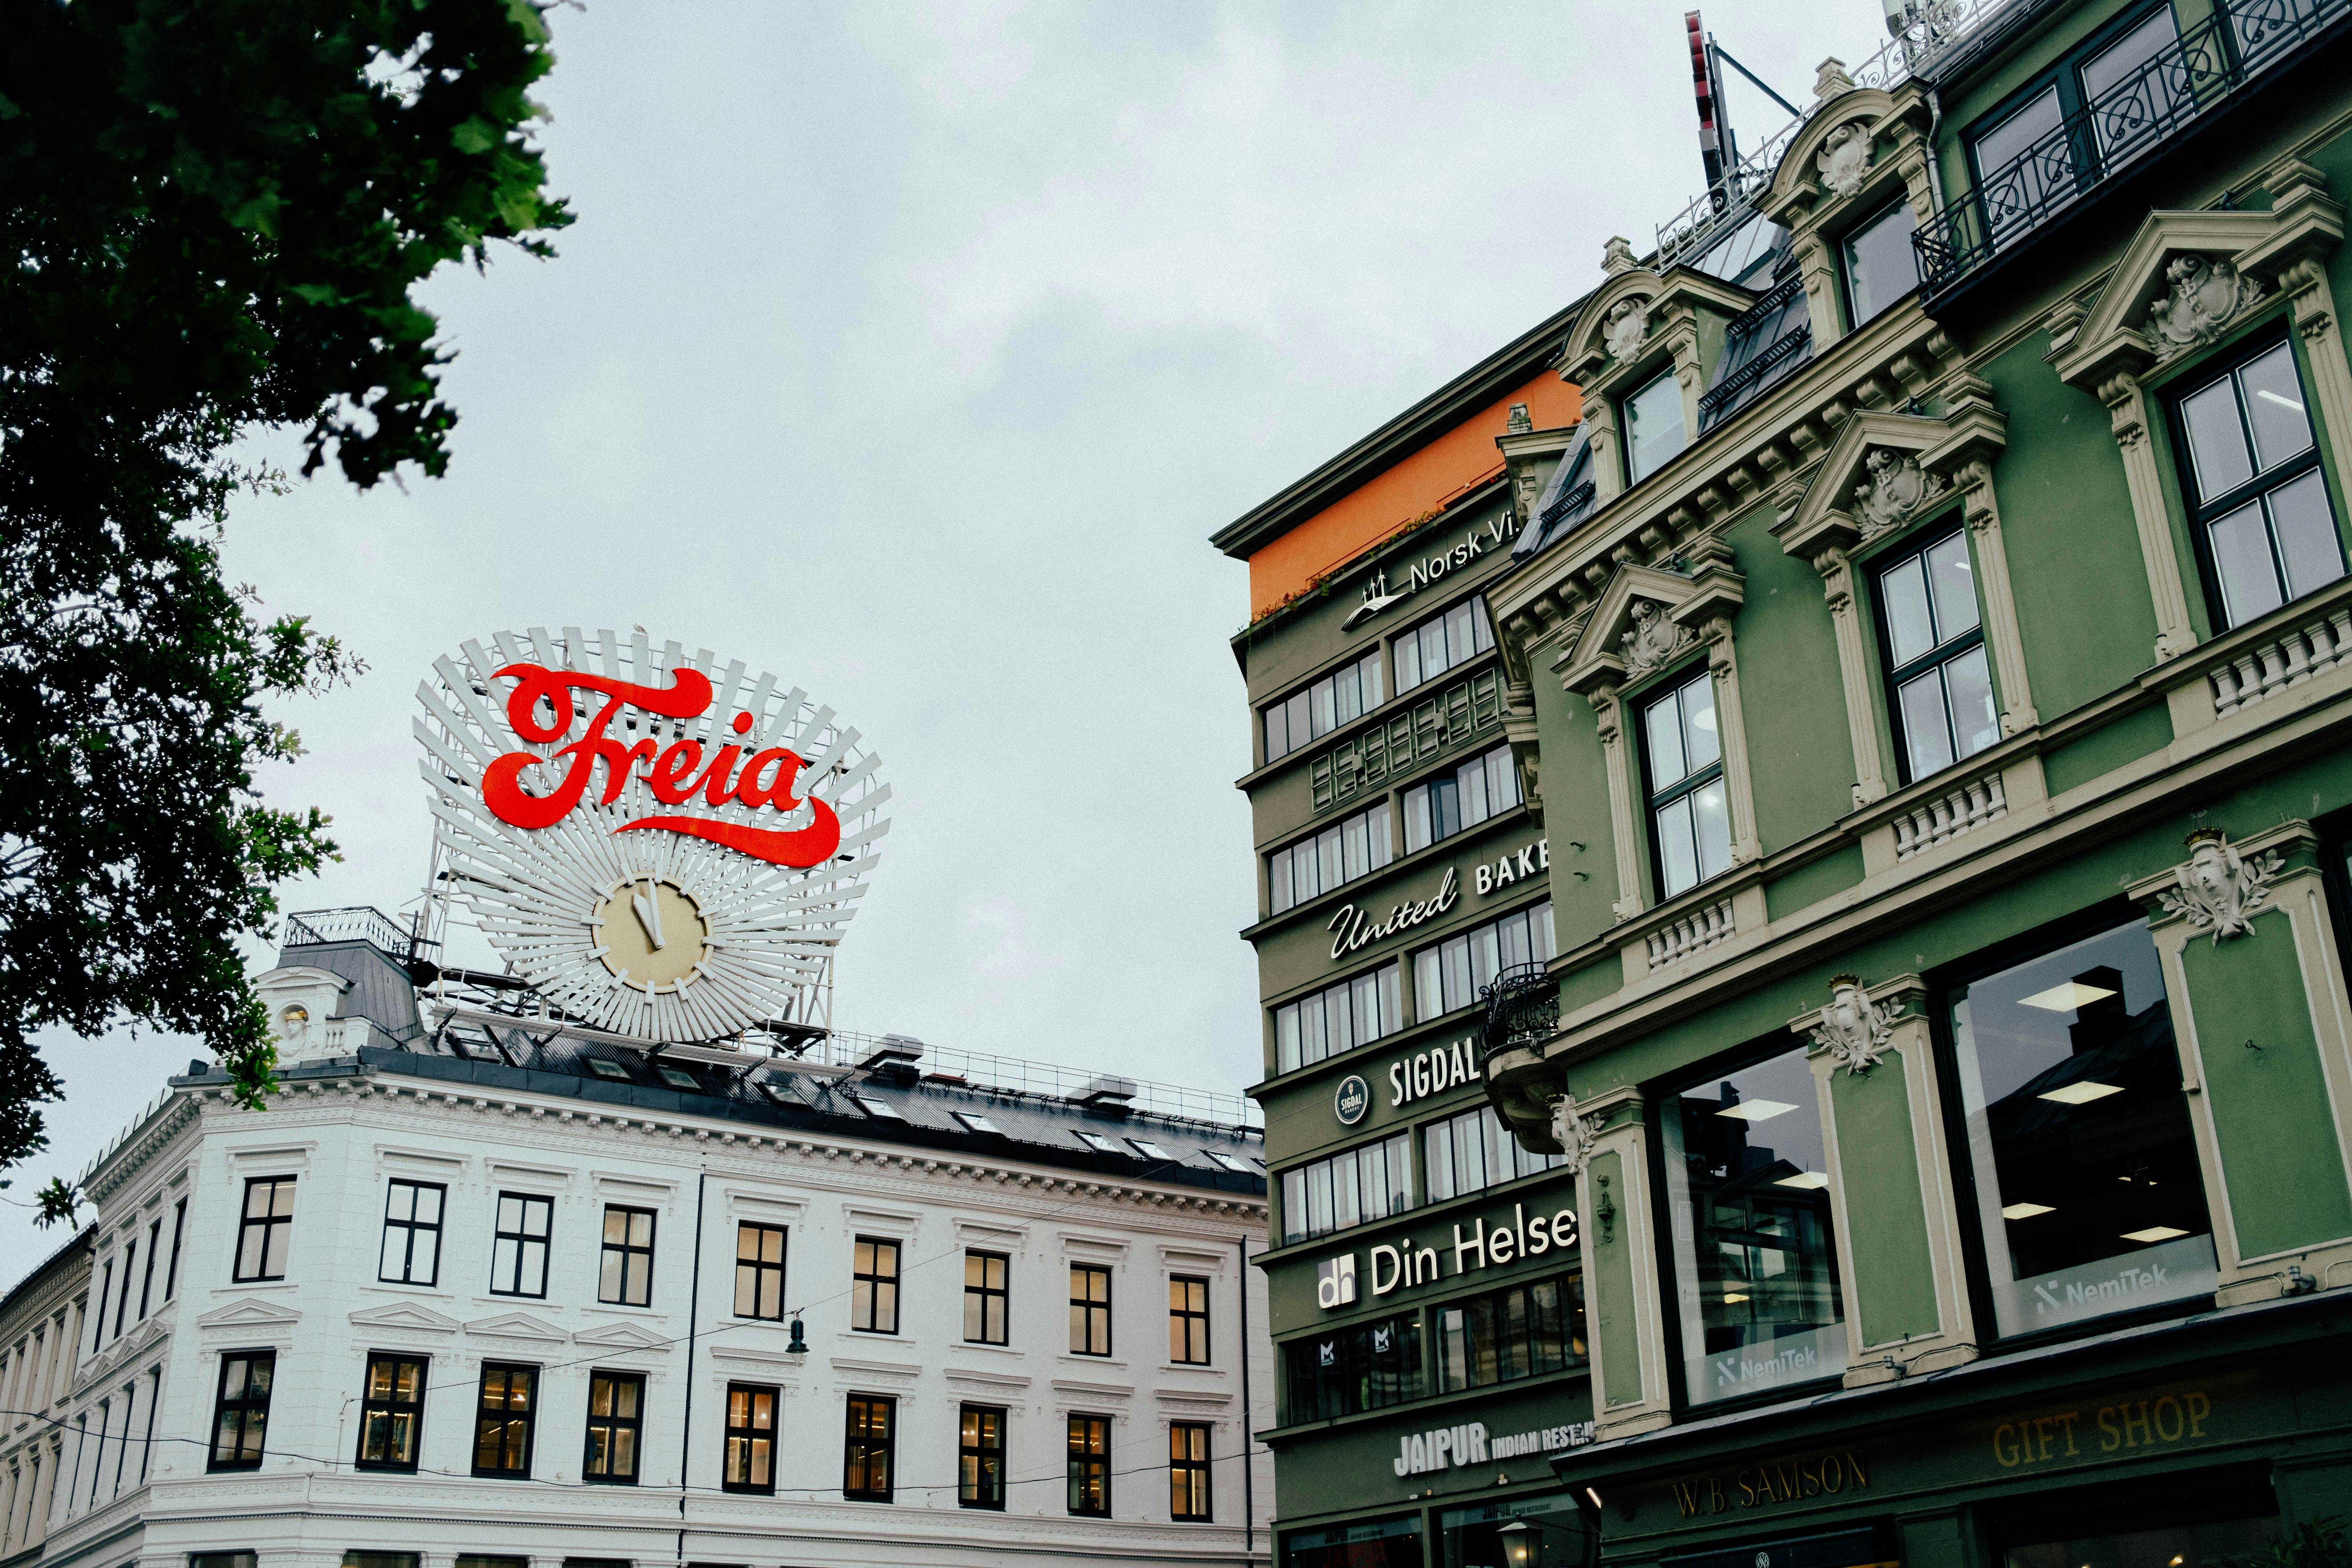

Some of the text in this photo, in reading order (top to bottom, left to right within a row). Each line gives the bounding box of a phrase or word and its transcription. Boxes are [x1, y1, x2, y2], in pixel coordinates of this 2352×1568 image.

[1411, 510, 1519, 590] Norsk Vi
[482, 663, 840, 867] Freia
[1327, 838, 1549, 959] United BAKE
[1341, 1093, 1362, 1110] SIGDAL
[1390, 1037, 1480, 1106] SIGDAL
[1371, 1239, 1438, 1295] Din
[1454, 1203, 1577, 1273] Helse
[2066, 1264, 2168, 1307] NemiTek
[1740, 1346, 1816, 1382] NemiTek
[1394, 1422, 1489, 1476] JAIPUR
[1491, 1431, 1538, 1459] INDIAN
[1994, 1392, 2210, 1467] GIFT SHOP
[1738, 1450, 1867, 1507] SAMSON
[1483, 1504, 1510, 1520] JAIPUR
